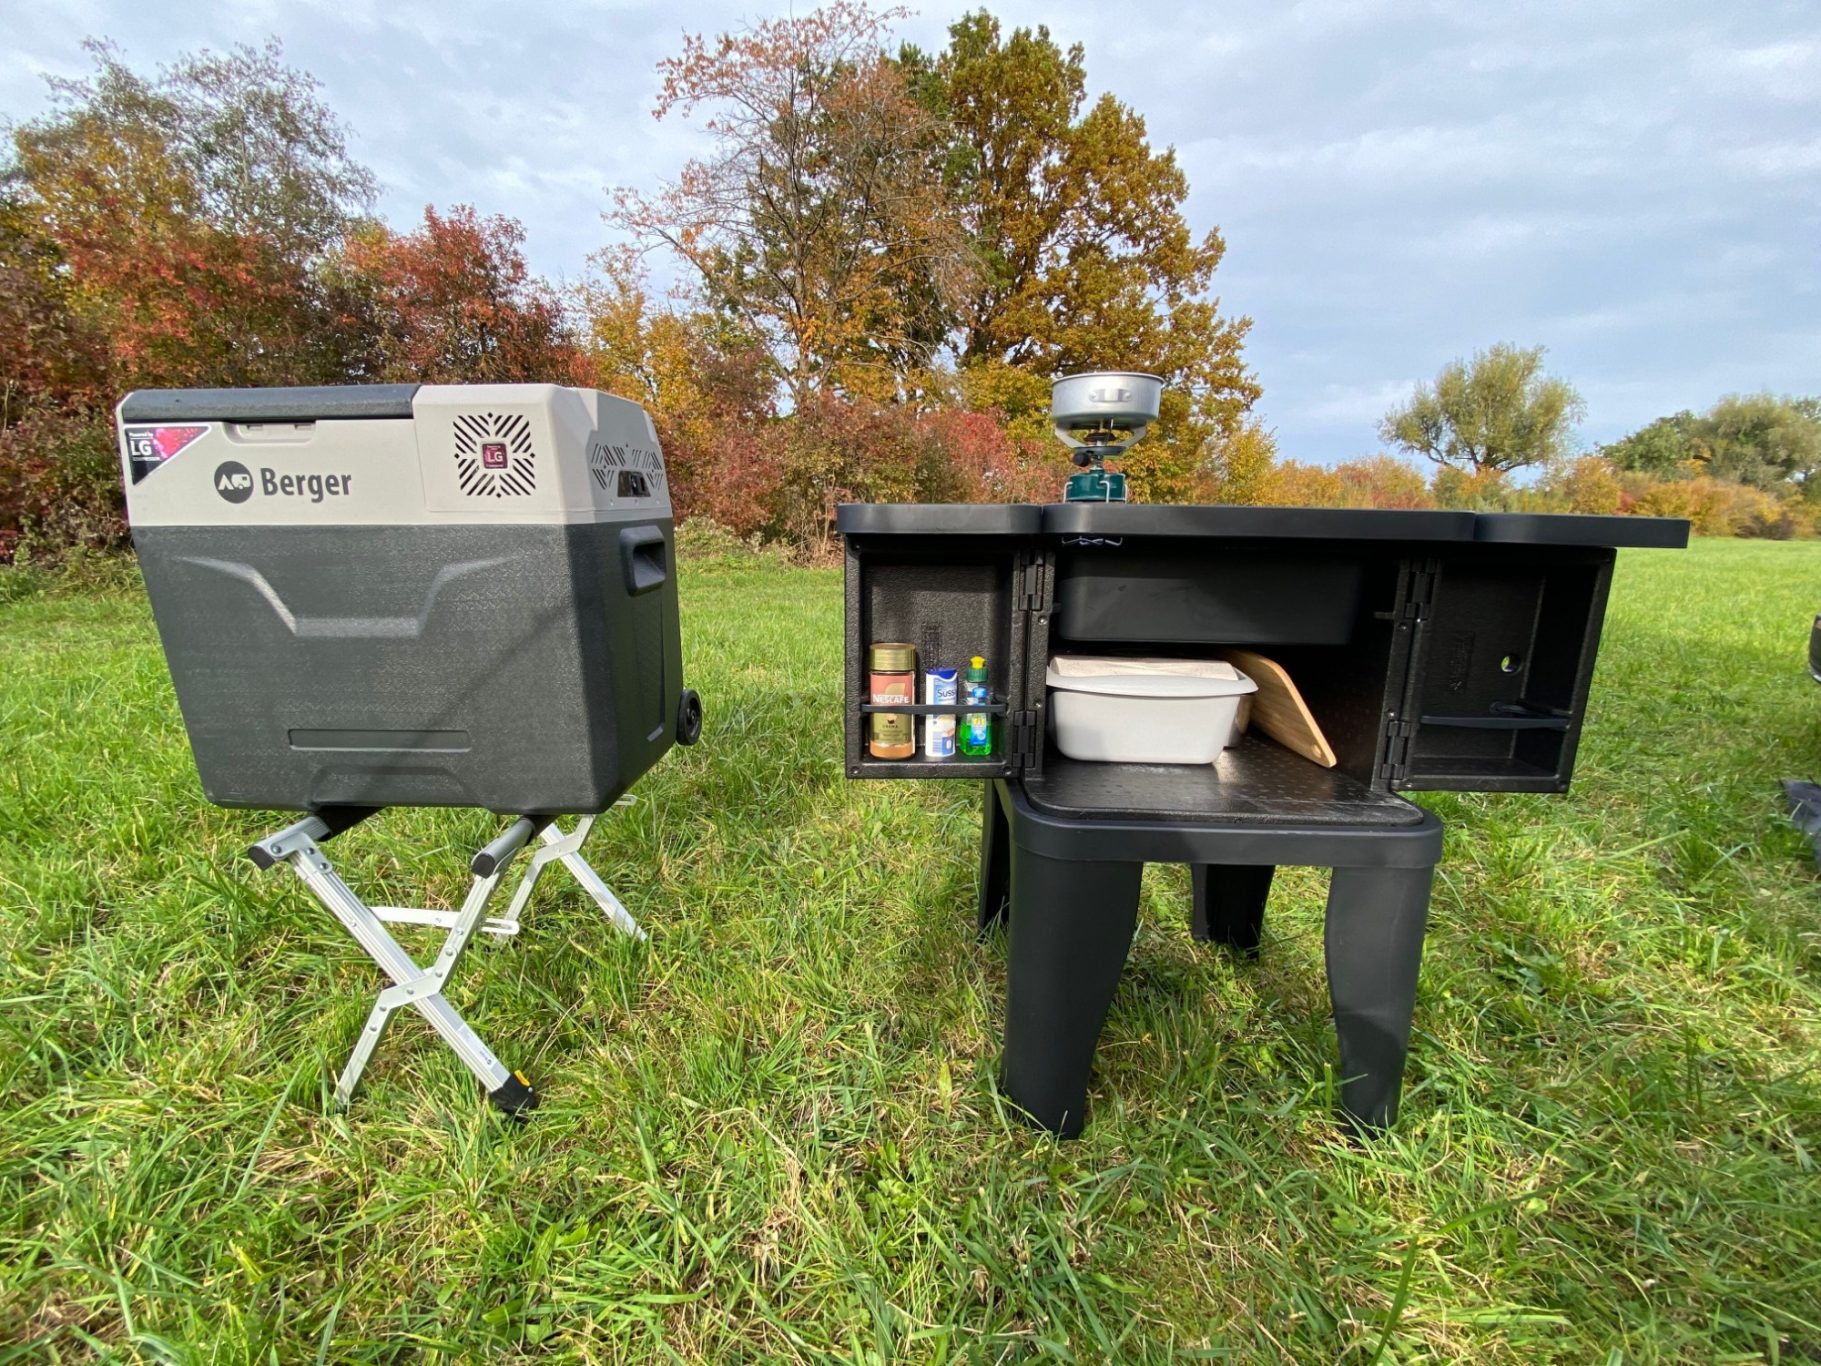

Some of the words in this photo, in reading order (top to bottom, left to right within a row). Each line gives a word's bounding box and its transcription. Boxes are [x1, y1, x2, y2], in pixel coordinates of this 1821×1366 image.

[130, 440, 152, 456] LG
[486, 451, 503, 463] LG
[260, 467, 351, 503] Berger
